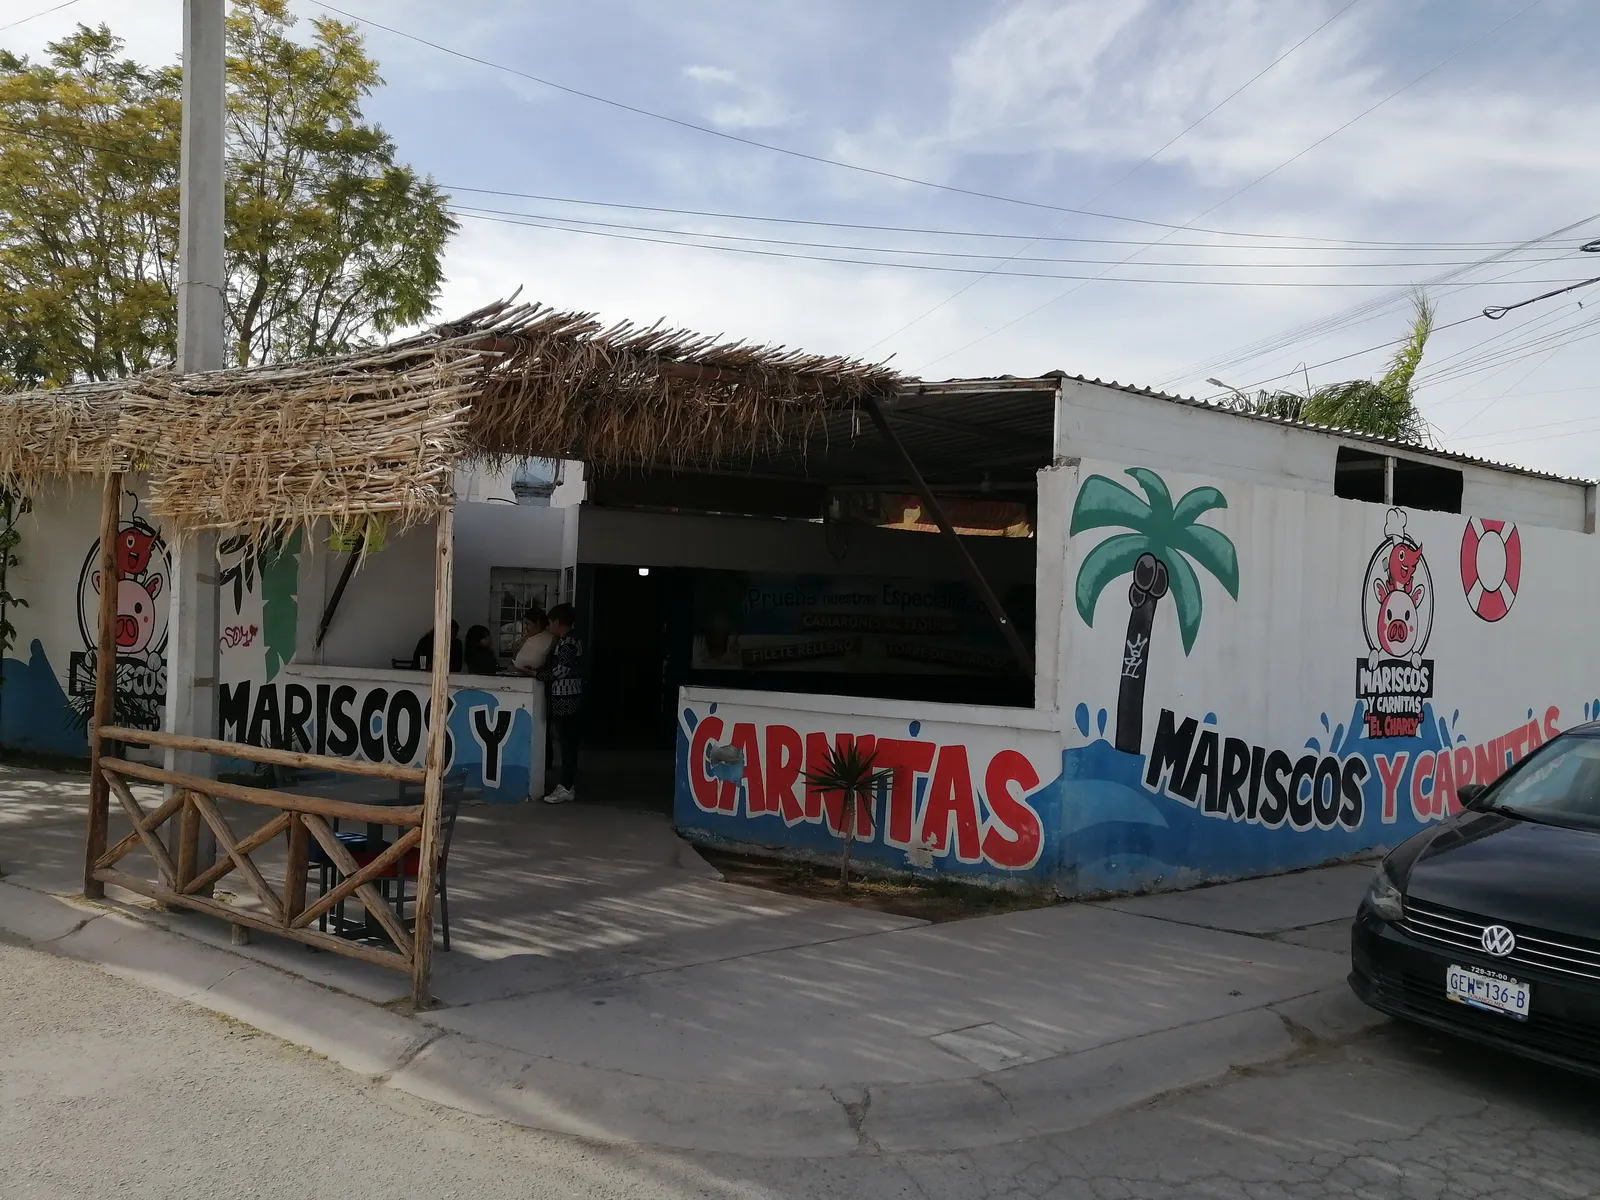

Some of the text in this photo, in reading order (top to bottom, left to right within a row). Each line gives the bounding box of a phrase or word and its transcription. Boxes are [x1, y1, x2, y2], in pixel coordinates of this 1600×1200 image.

[803, 615, 881, 629] CAMARONES
[752, 647, 794, 661] FILETE
[1360, 666, 1430, 695] MARISCOS
[1367, 696, 1422, 714] Y CARNITAS
[474, 709, 512, 782] Y
[1145, 707, 1368, 827] MARISCOS
[1374, 755, 1406, 818] Y
[690, 715, 1041, 868] CARNITAS
[1450, 973, 1526, 1009] GEW-136-B
